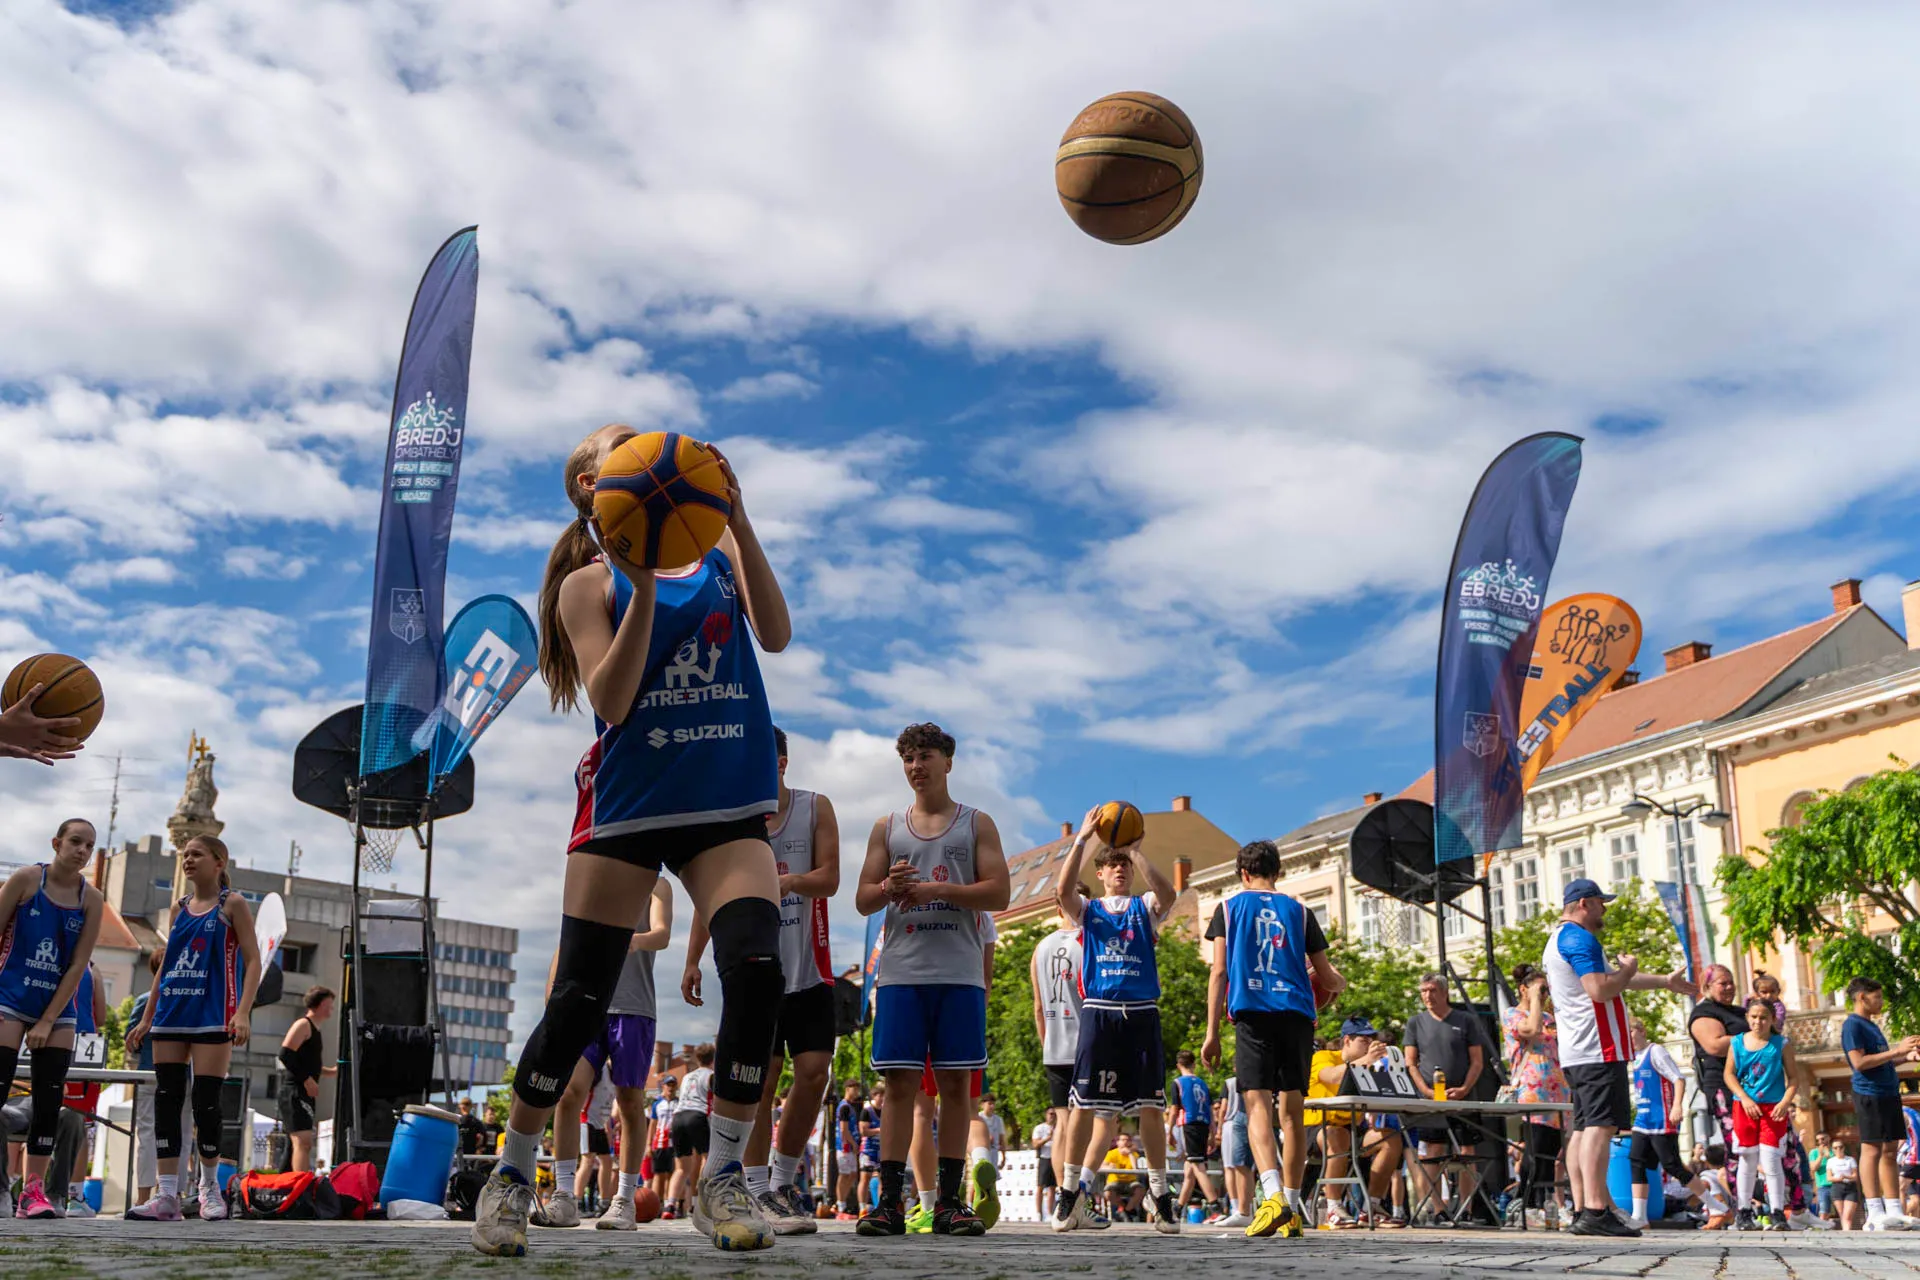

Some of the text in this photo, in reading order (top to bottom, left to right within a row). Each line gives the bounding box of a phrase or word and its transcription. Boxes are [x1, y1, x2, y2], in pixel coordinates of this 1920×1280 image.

[673, 724, 744, 743] SUZUKI
[780, 917, 800, 926] ZUKI
[917, 923, 958, 931] SUZUKI
[172, 988, 205, 996] SUZUKI
[84, 1040, 95, 1061] 4
[739, 1064, 761, 1084] NBA
[1099, 1070, 1117, 1093] 12
[1361, 1072, 1372, 1090] 1
[536, 1075, 559, 1092] NBA
